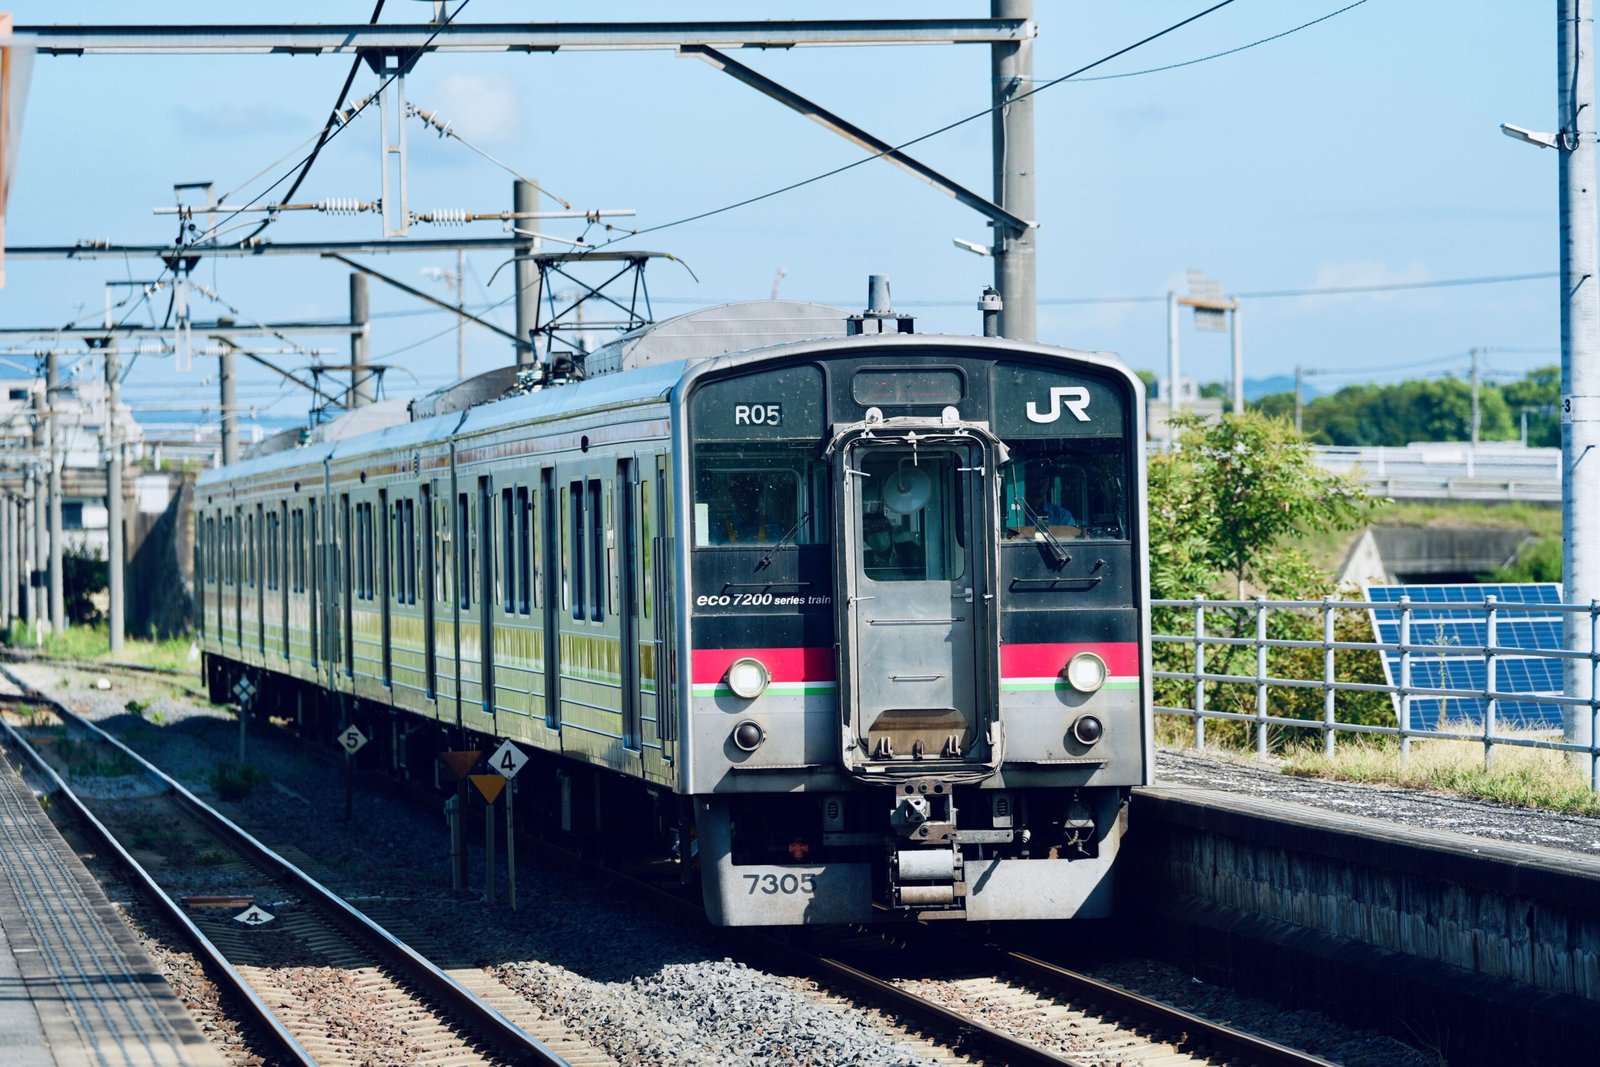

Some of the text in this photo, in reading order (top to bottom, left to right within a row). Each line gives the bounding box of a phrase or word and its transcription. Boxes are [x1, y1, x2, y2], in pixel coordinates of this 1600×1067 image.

[735, 404, 781, 426] R05
[1026, 386, 1091, 423] JR
[696, 593, 831, 606] eco 7200 series train
[346, 732, 359, 748] 5
[500, 749, 516, 771] 4
[742, 873, 817, 895] 7305
[246, 911, 264, 922] 4
